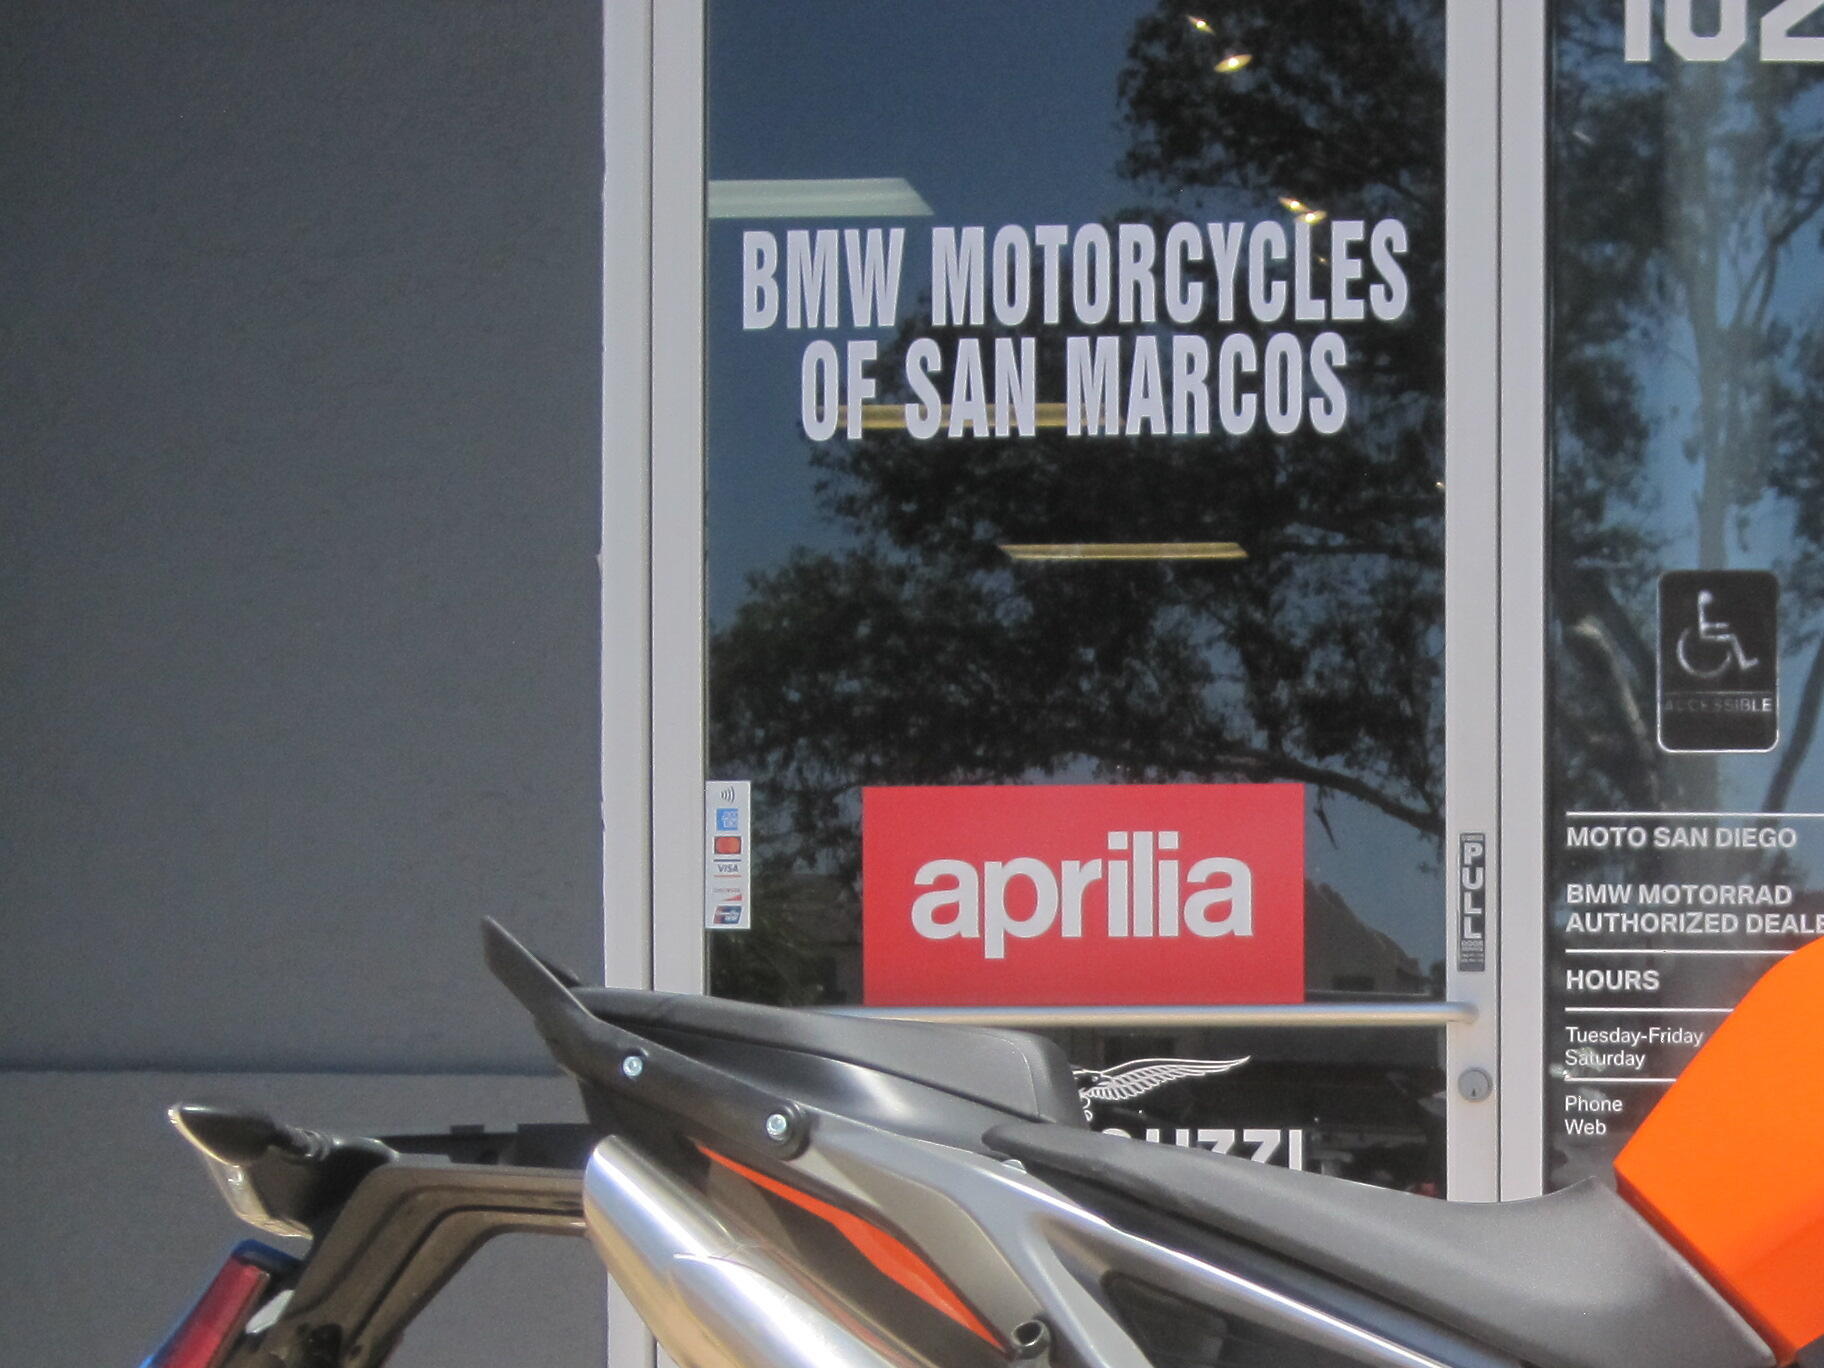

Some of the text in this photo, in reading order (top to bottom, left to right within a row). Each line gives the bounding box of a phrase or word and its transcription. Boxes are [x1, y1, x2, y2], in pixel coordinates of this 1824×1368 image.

[742, 219, 1408, 330] BMW MOTORCYCLES
[801, 332, 1348, 442] OF SAN MARCOS
[1664, 697, 1772, 713] ACCESSIBLE
[1566, 827, 1798, 849] MOTO SAN DIEGO
[911, 831, 1254, 959] aprilia
[1461, 842, 1484, 939] PULL
[1566, 884, 1793, 906] BMW MOTORRAD
[1565, 912, 1739, 934] AUTHORIZED
[1566, 969, 1660, 991] HOURS
[1565, 1027, 1704, 1047] Tuesday-Friday
[1565, 1048, 1646, 1070] Saturday
[1565, 1095, 1623, 1113] Phone
[1565, 1118, 1607, 1135] Web
